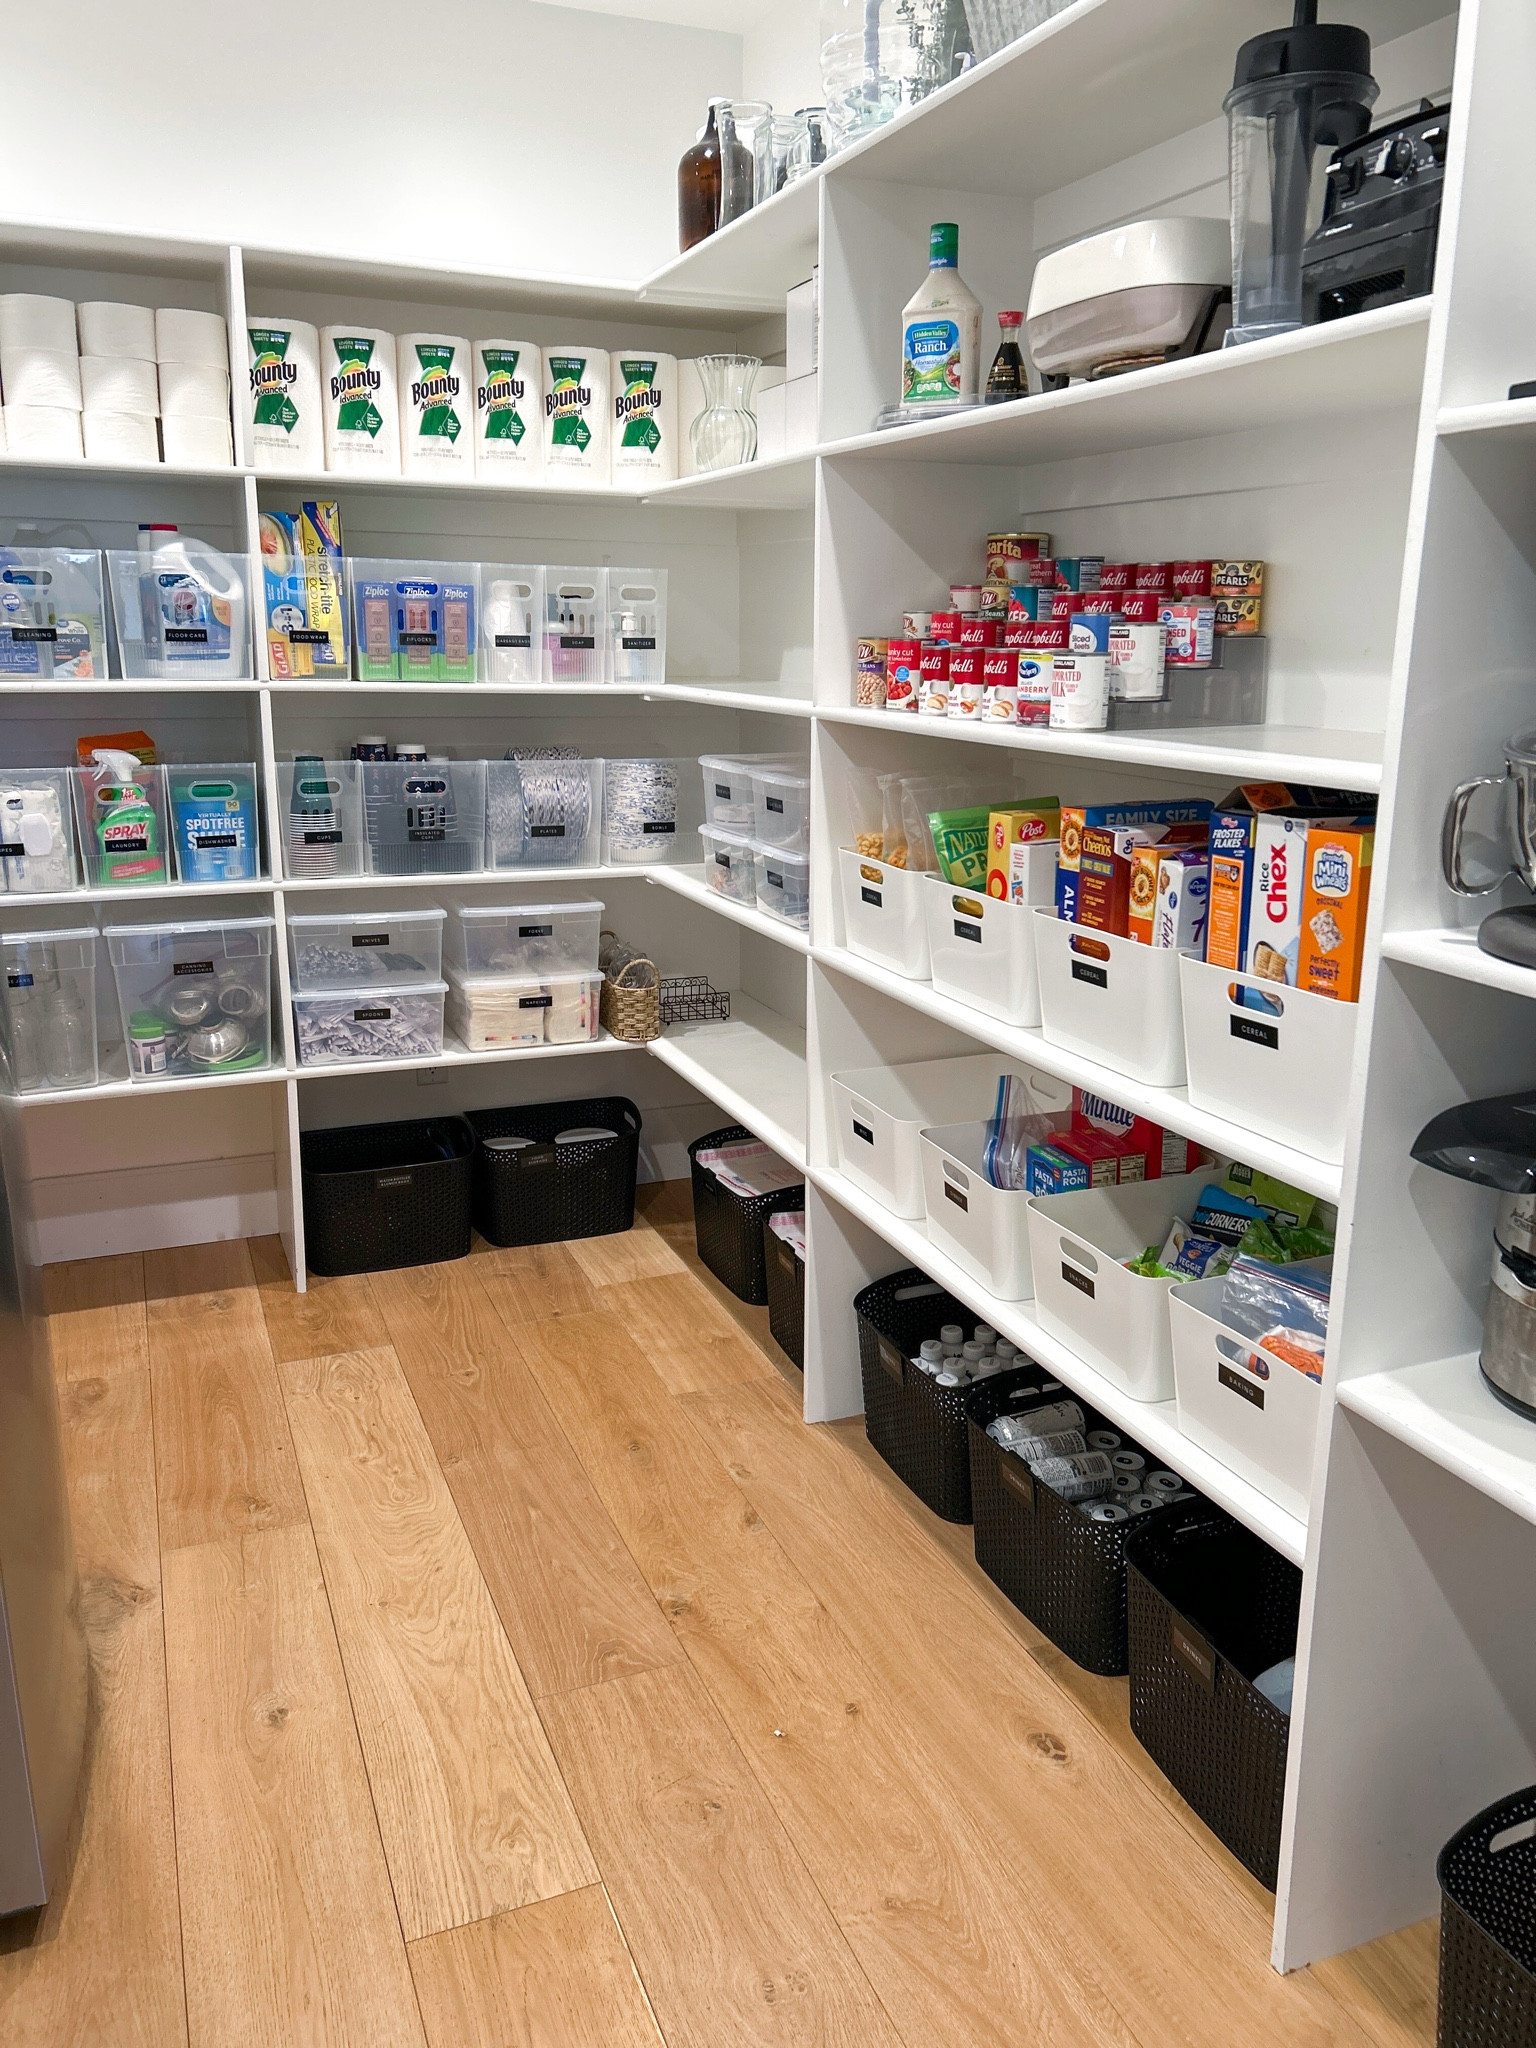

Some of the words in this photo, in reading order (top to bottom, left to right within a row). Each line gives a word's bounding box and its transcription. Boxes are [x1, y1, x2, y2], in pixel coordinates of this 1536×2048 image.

[914, 340, 948, 354] Ranch
[248, 361, 297, 392] Bounty
[331, 368, 381, 401] Bounty
[254, 385, 288, 400] Advanced
[411, 375, 460, 406] Bounty
[477, 378, 525, 410] Bounty
[419, 397, 453, 413] Advanced
[485, 400, 517, 416] Advanced
[545, 385, 591, 417] Bounty
[615, 387, 662, 419] Bounty
[623, 410, 654, 425] Advanced
[317, 546, 332, 615] stretch-tite
[1217, 576, 1248, 586] PEARLS
[365, 586, 390, 598] Ziploc
[405, 587, 430, 599] Ziploc
[444, 588, 468, 600] Ziploc
[311, 601, 321, 629] WRAP
[1072, 635, 1091, 643] Sliced
[901, 648, 914, 657] cut
[185, 817, 245, 831] SPOTFREE
[1105, 810, 1161, 826] FAMILY
[1165, 808, 1198, 821] SIZE
[104, 822, 148, 840] SPRAY
[1021, 822, 1044, 840] Post
[1212, 828, 1245, 840] FROSTED
[1213, 838, 1242, 849] FLAKES
[1260, 862, 1270, 892] Rice
[1317, 861, 1348, 877] Mini
[1267, 843, 1288, 923] Chex
[1314, 875, 1350, 892] Wheats
[960, 926, 976, 937] CEREAL
[1079, 967, 1100, 980] CEREAL
[1309, 965, 1340, 982] sweet
[1240, 1024, 1268, 1040] CEREAL
[1081, 1091, 1135, 1128] Minute
[1034, 1167, 1054, 1188] PASTA
[1062, 1168, 1087, 1177] PASTA
[1062, 1175, 1087, 1187] RONI
[1178, 1256, 1203, 1274] VEGGIE
[1069, 1272, 1089, 1290] SNACKS
[1228, 1376, 1254, 1397] BAKING
[1182, 1641, 1202, 1665] DRINKS
